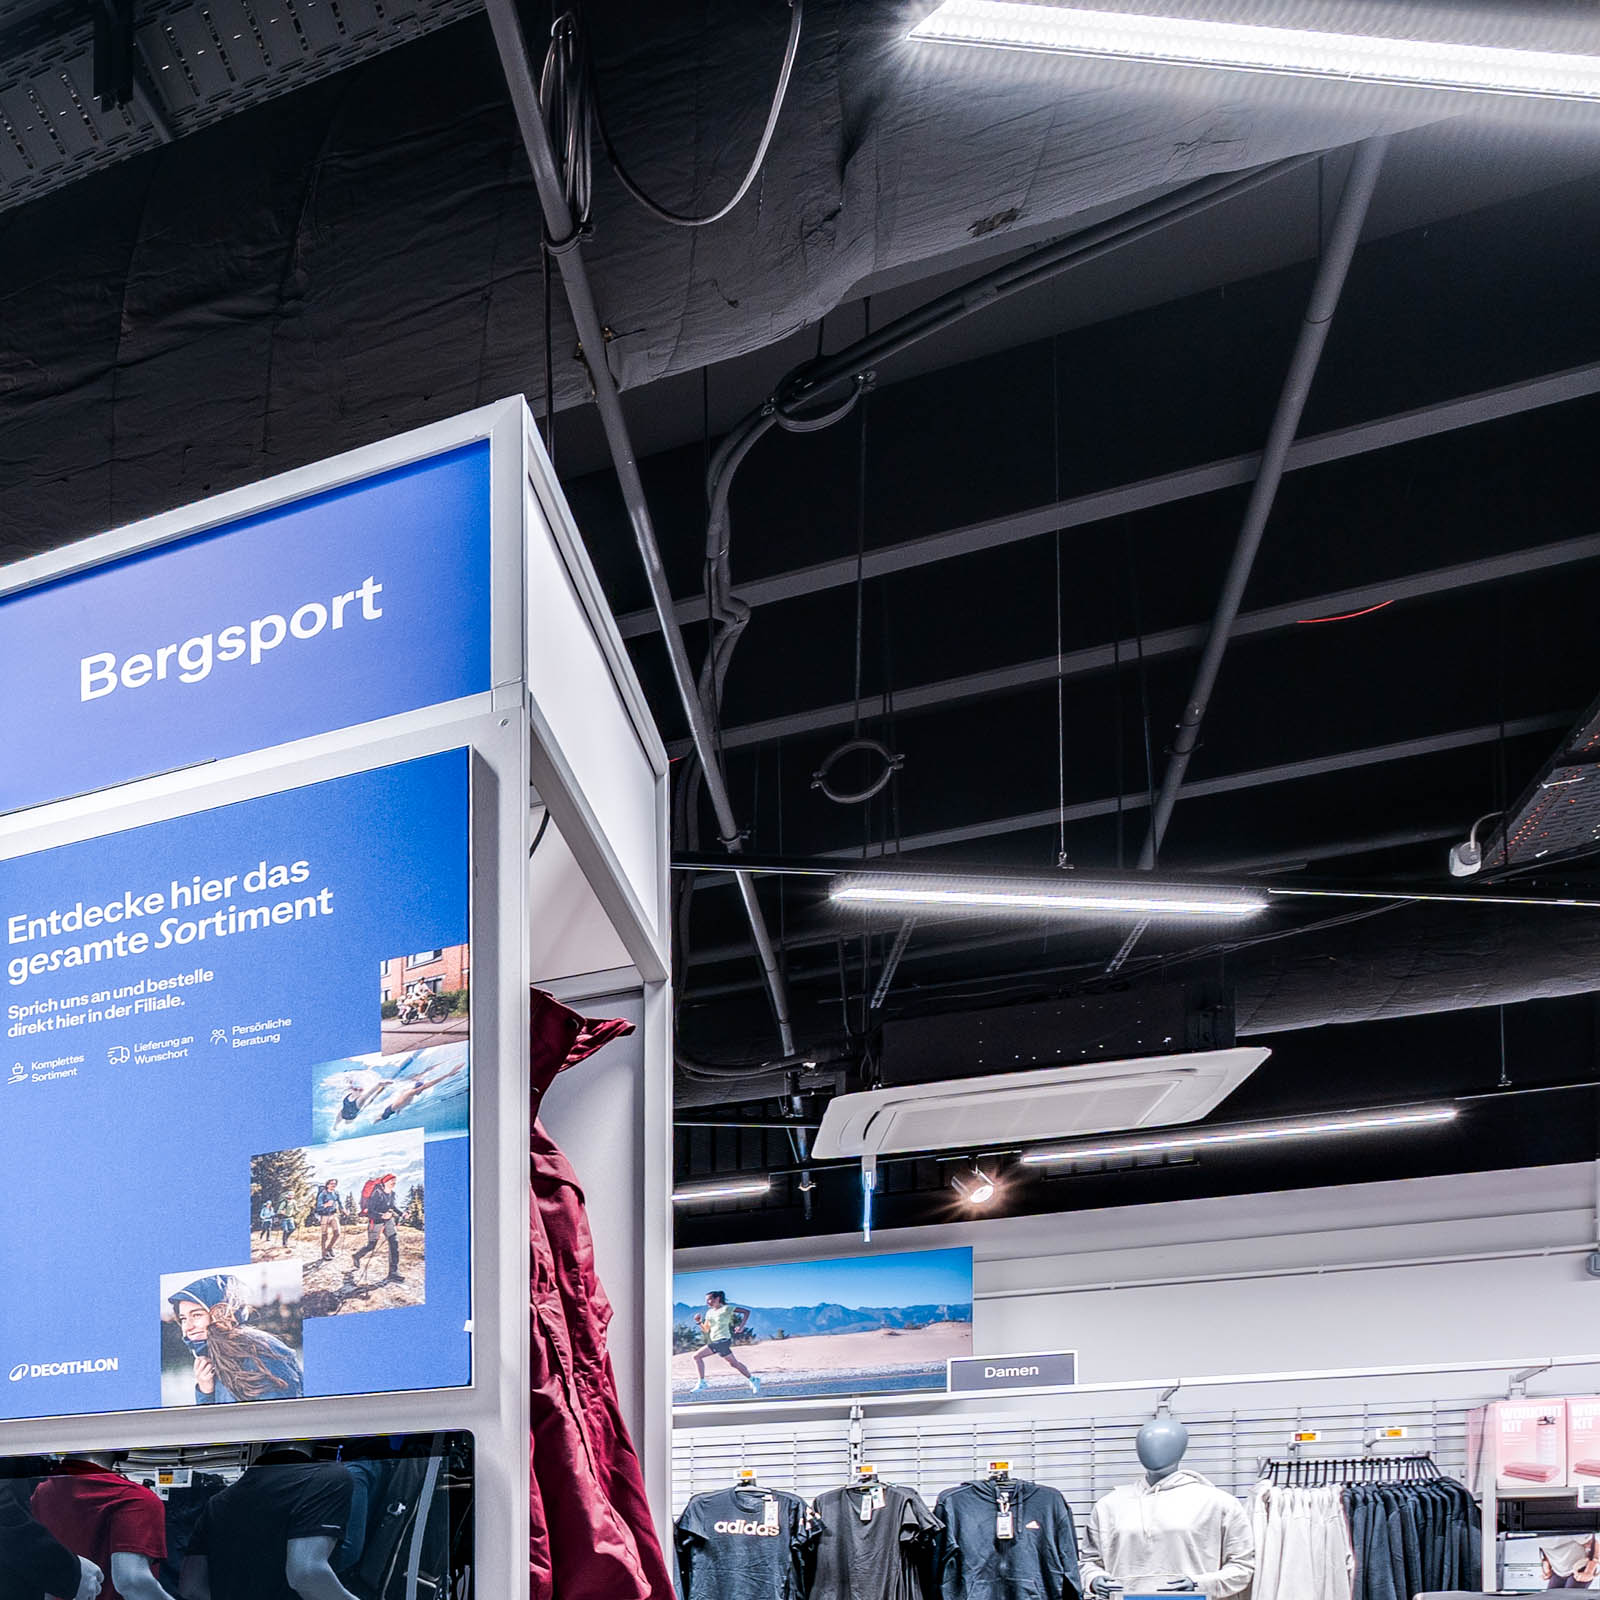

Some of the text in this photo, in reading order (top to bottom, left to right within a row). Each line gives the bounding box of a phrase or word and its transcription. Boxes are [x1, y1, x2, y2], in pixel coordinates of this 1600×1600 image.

[80, 575, 383, 702] Bergsport
[7, 860, 310, 945] Entdecke hier das
[7, 886, 334, 985] gesamte Sortiment
[7, 968, 214, 1021] Sprich uns an und bestelle
[7, 993, 186, 1038] direkt hier in der Filiale.
[232, 1016, 292, 1036] Persönliche
[134, 1035, 194, 1055] Lieferung an
[232, 1032, 281, 1049] Beratung
[31, 1053, 85, 1072] Komplettes
[134, 1047, 189, 1065] Wunschort
[31, 1067, 78, 1083] Sortiment
[31, 1357, 119, 1378] DECATHLON
[984, 1365, 1040, 1379] Damen
[1502, 1419, 1522, 1433] KIT
[1573, 1415, 1593, 1430] KIT
[714, 1518, 780, 1537] adidas
